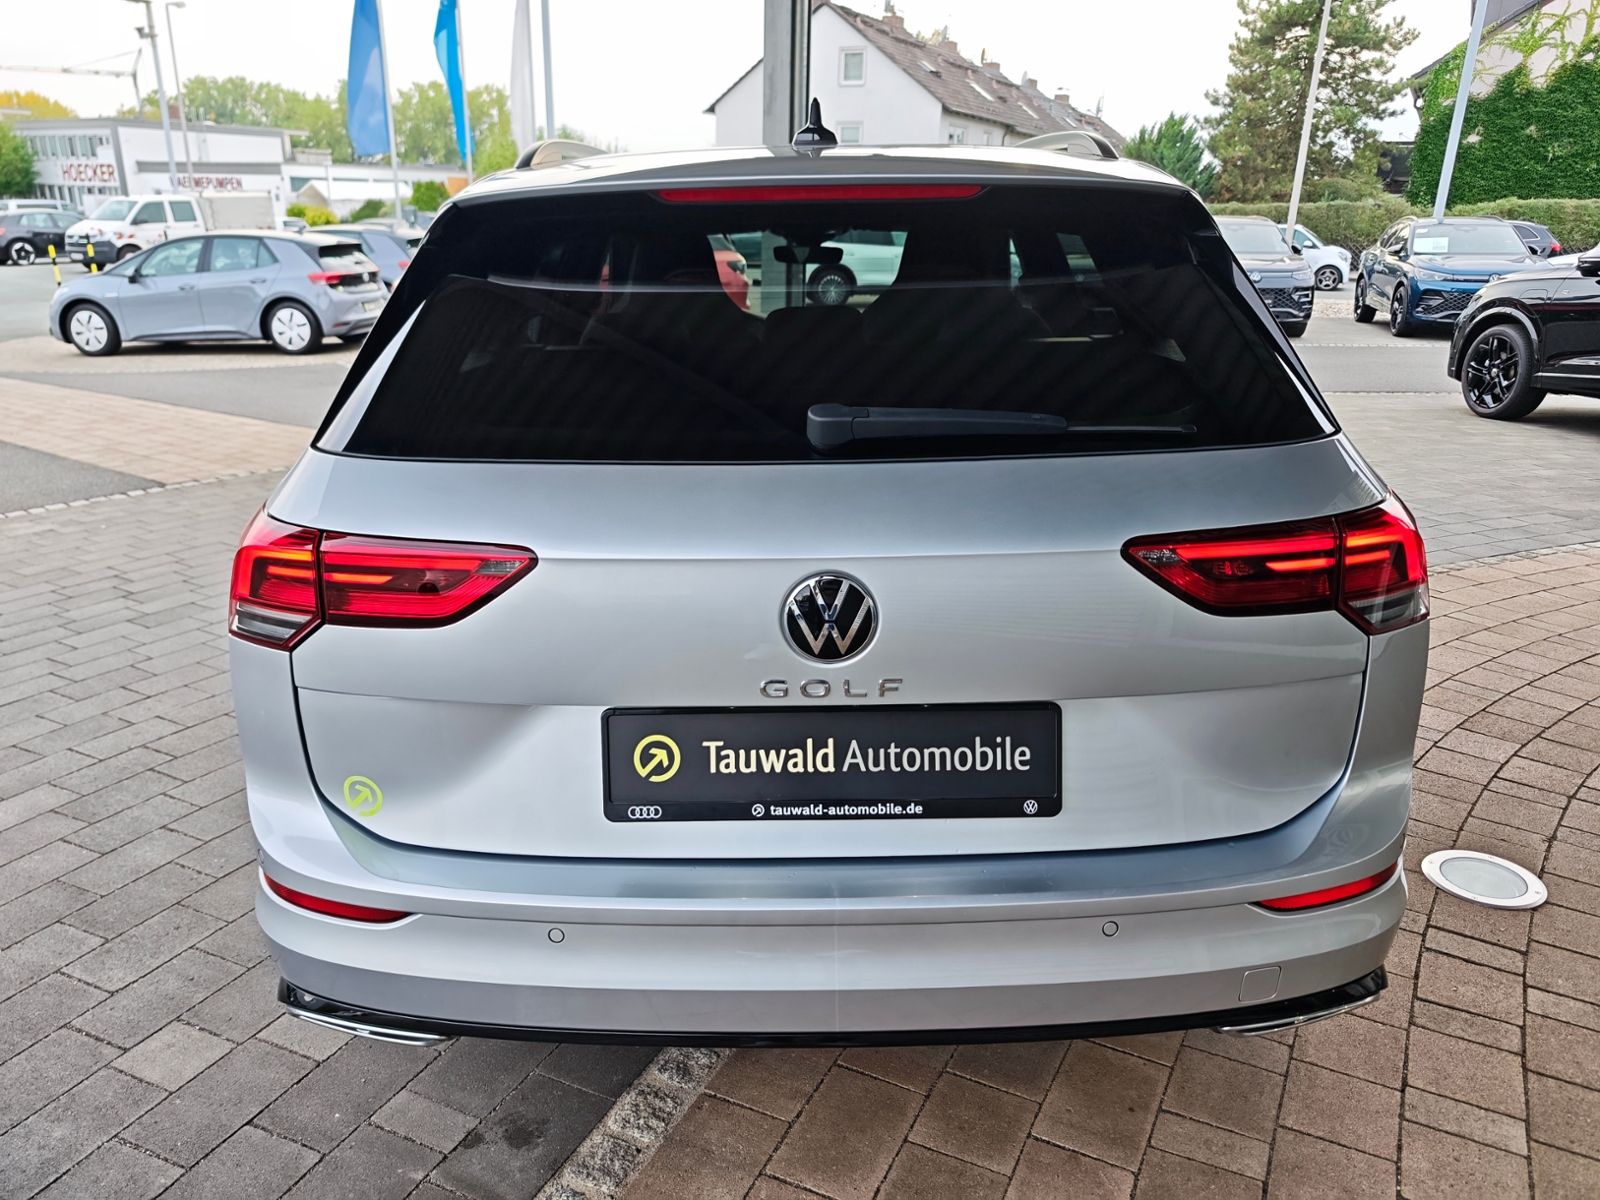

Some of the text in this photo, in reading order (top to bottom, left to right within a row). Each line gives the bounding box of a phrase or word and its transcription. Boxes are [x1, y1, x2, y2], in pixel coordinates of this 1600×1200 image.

[61, 163, 117, 182] HOECKER
[785, 574, 876, 661] VW
[760, 678, 903, 699] GOLF
[702, 736, 1031, 774] Tauwald Automobile
[770, 803, 923, 816] tauwald-automobile.de
